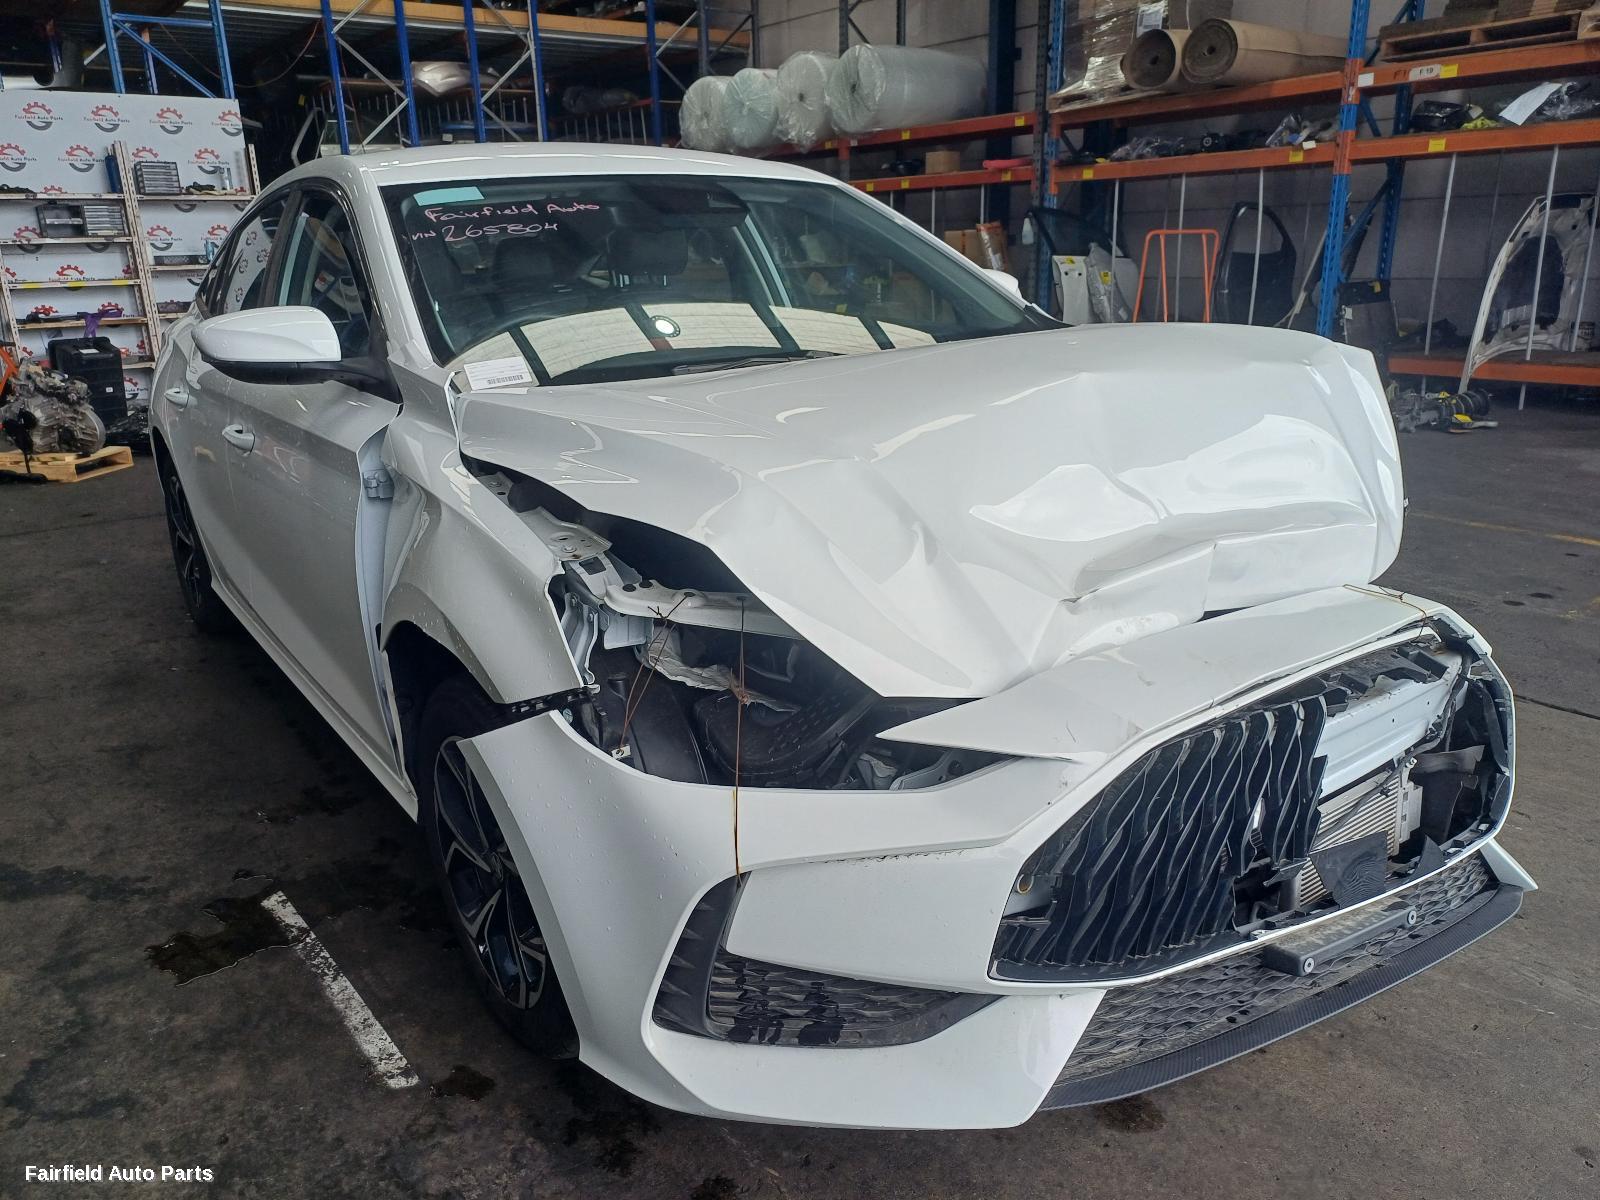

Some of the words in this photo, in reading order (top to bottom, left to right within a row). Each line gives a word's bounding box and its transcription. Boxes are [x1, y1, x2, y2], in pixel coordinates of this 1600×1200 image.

[424, 204, 538, 222] Fairfield
[547, 202, 600, 213] Auto
[412, 230, 436, 241] VIN
